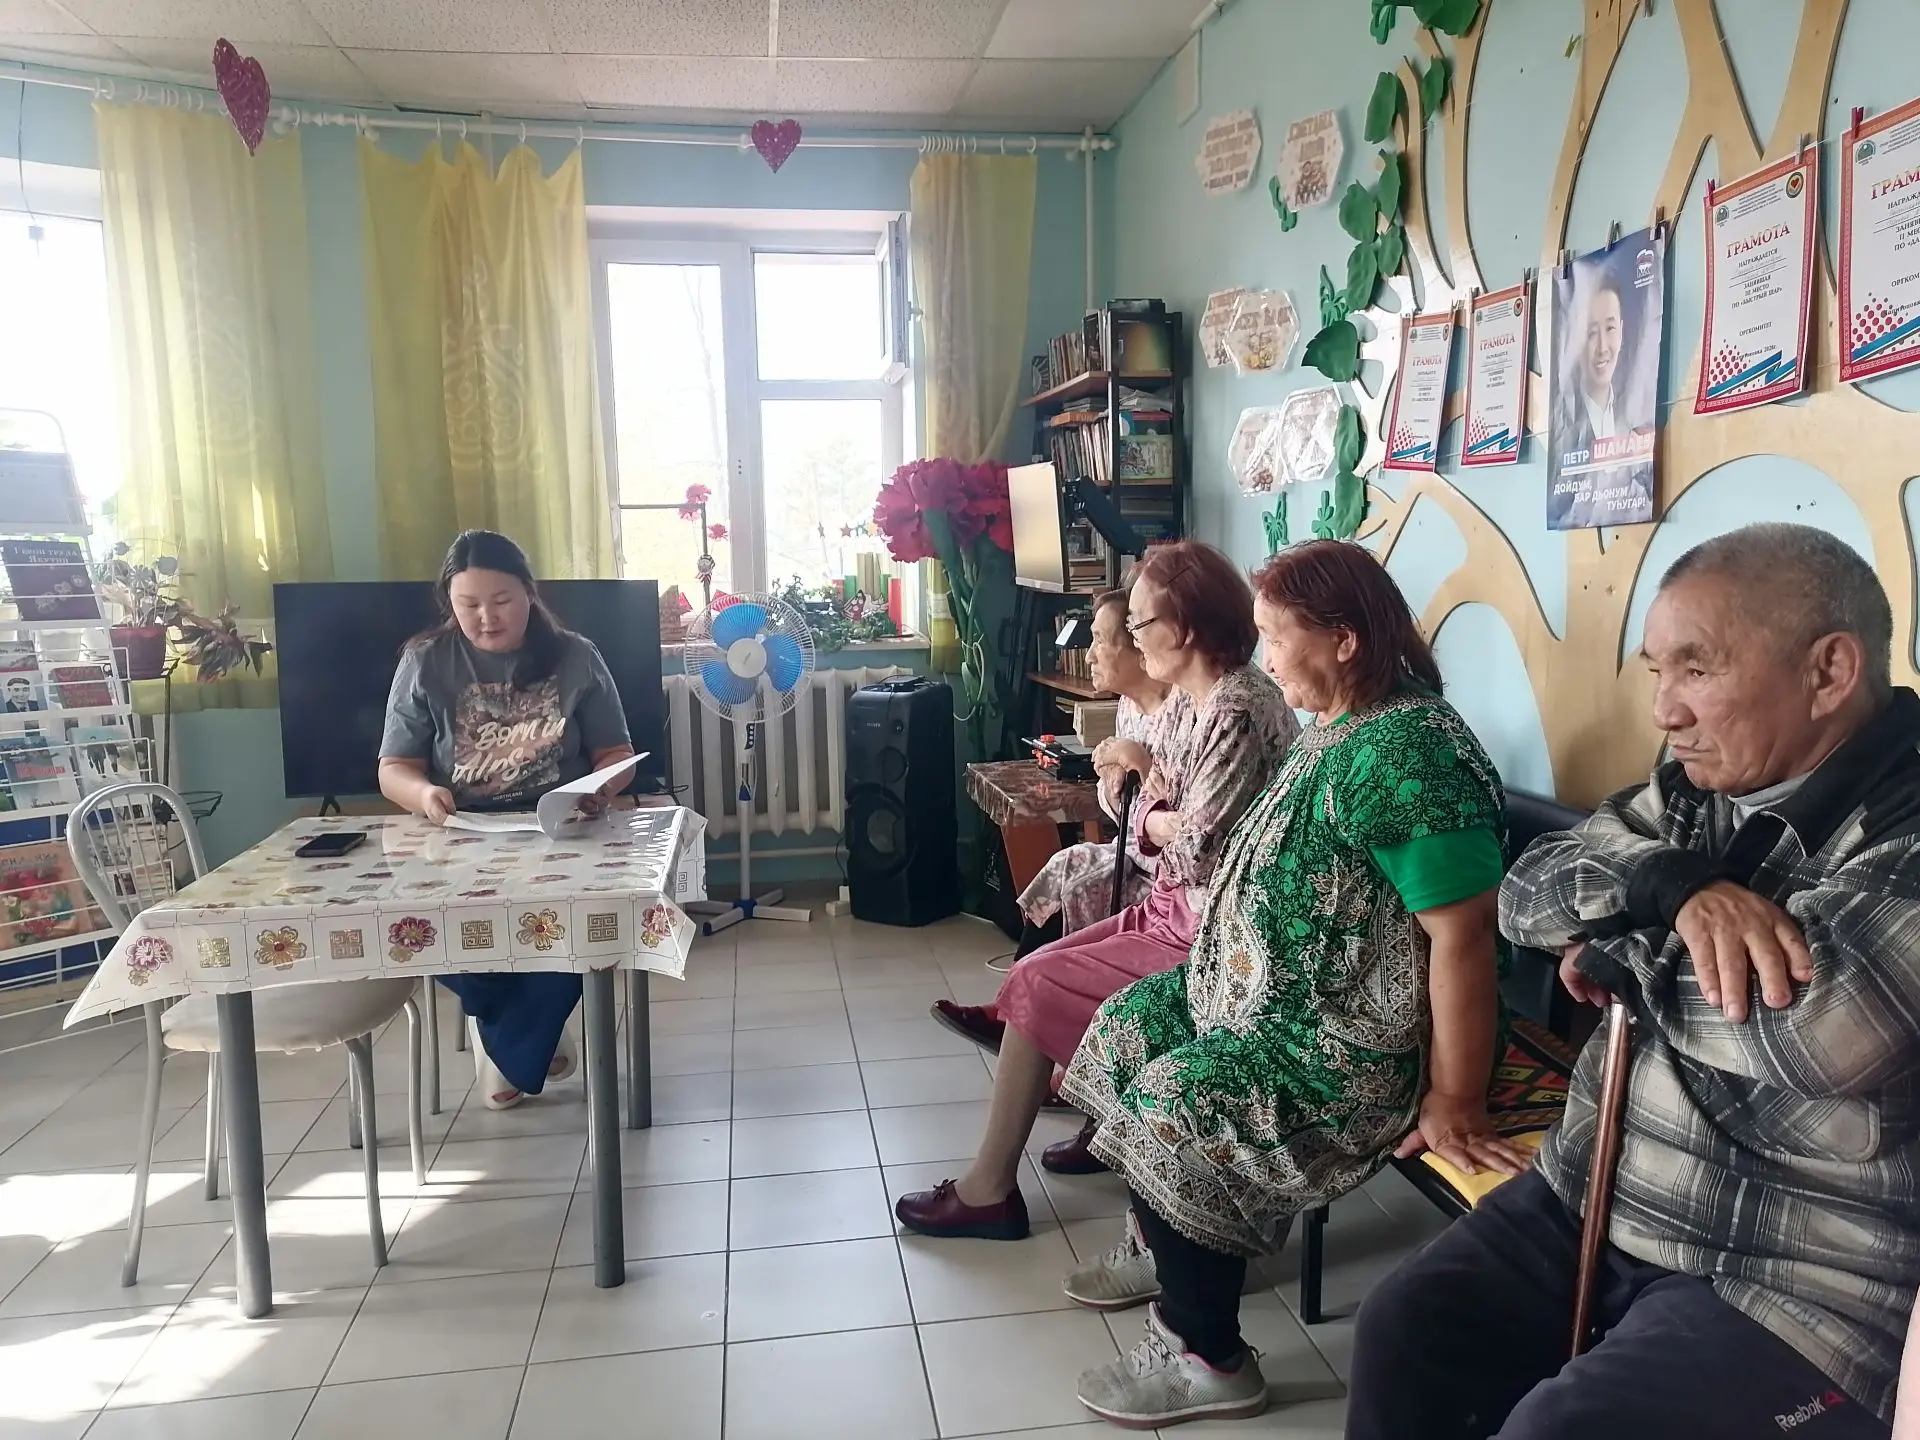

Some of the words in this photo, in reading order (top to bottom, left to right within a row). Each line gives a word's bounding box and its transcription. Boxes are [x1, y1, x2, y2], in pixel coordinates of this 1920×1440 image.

[1726, 222, 1790, 258] ГРАМОТА
[1894, 242, 1906, 251] ПО
[1731, 301, 1740, 309] ПО
[1480, 333, 1516, 351] ГРАМОТА
[1563, 449, 1590, 465] ПЕТР
[475, 719, 536, 751] Born
[541, 717, 566, 738] in
[1774, 1396, 1826, 1433] Reebok
